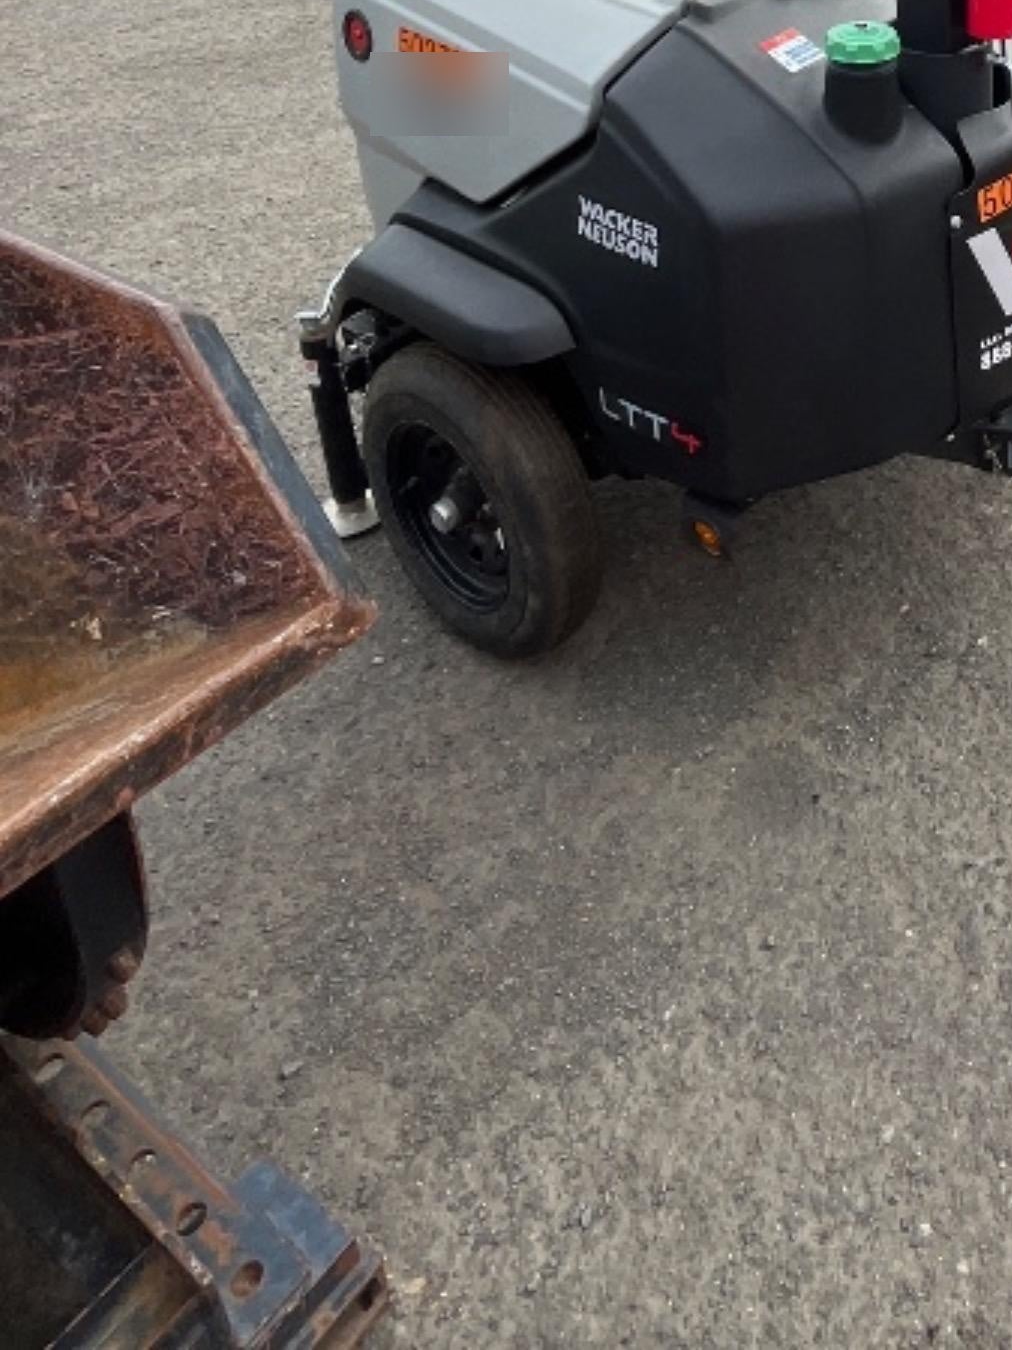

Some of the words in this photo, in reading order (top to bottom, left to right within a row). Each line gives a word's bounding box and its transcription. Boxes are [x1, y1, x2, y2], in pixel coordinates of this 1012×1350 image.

[578, 193, 659, 247] WACKER
[578, 215, 659, 269] NEUSON
[599, 386, 702, 455] LTT4
